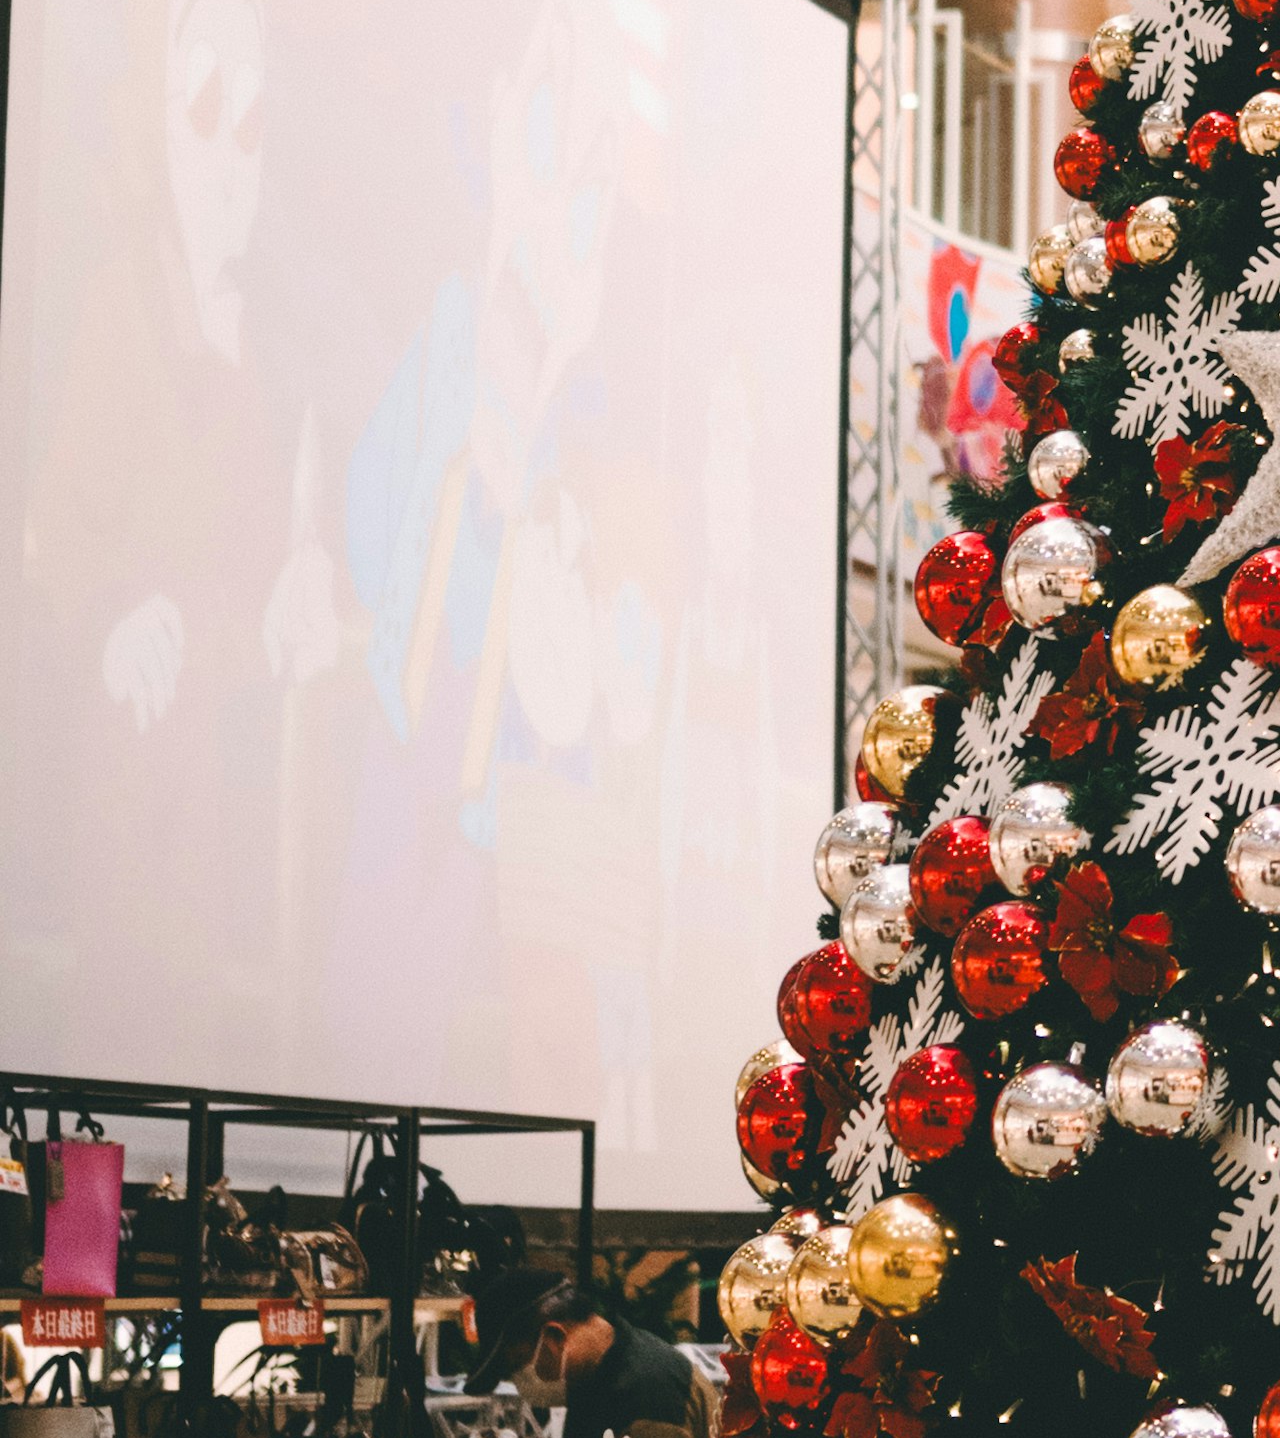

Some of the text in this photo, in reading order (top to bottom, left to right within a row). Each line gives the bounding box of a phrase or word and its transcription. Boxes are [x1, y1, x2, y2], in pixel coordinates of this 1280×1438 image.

[32, 1308, 96, 1339] 本日最終日
[265, 1307, 318, 1336] 本日最終日
